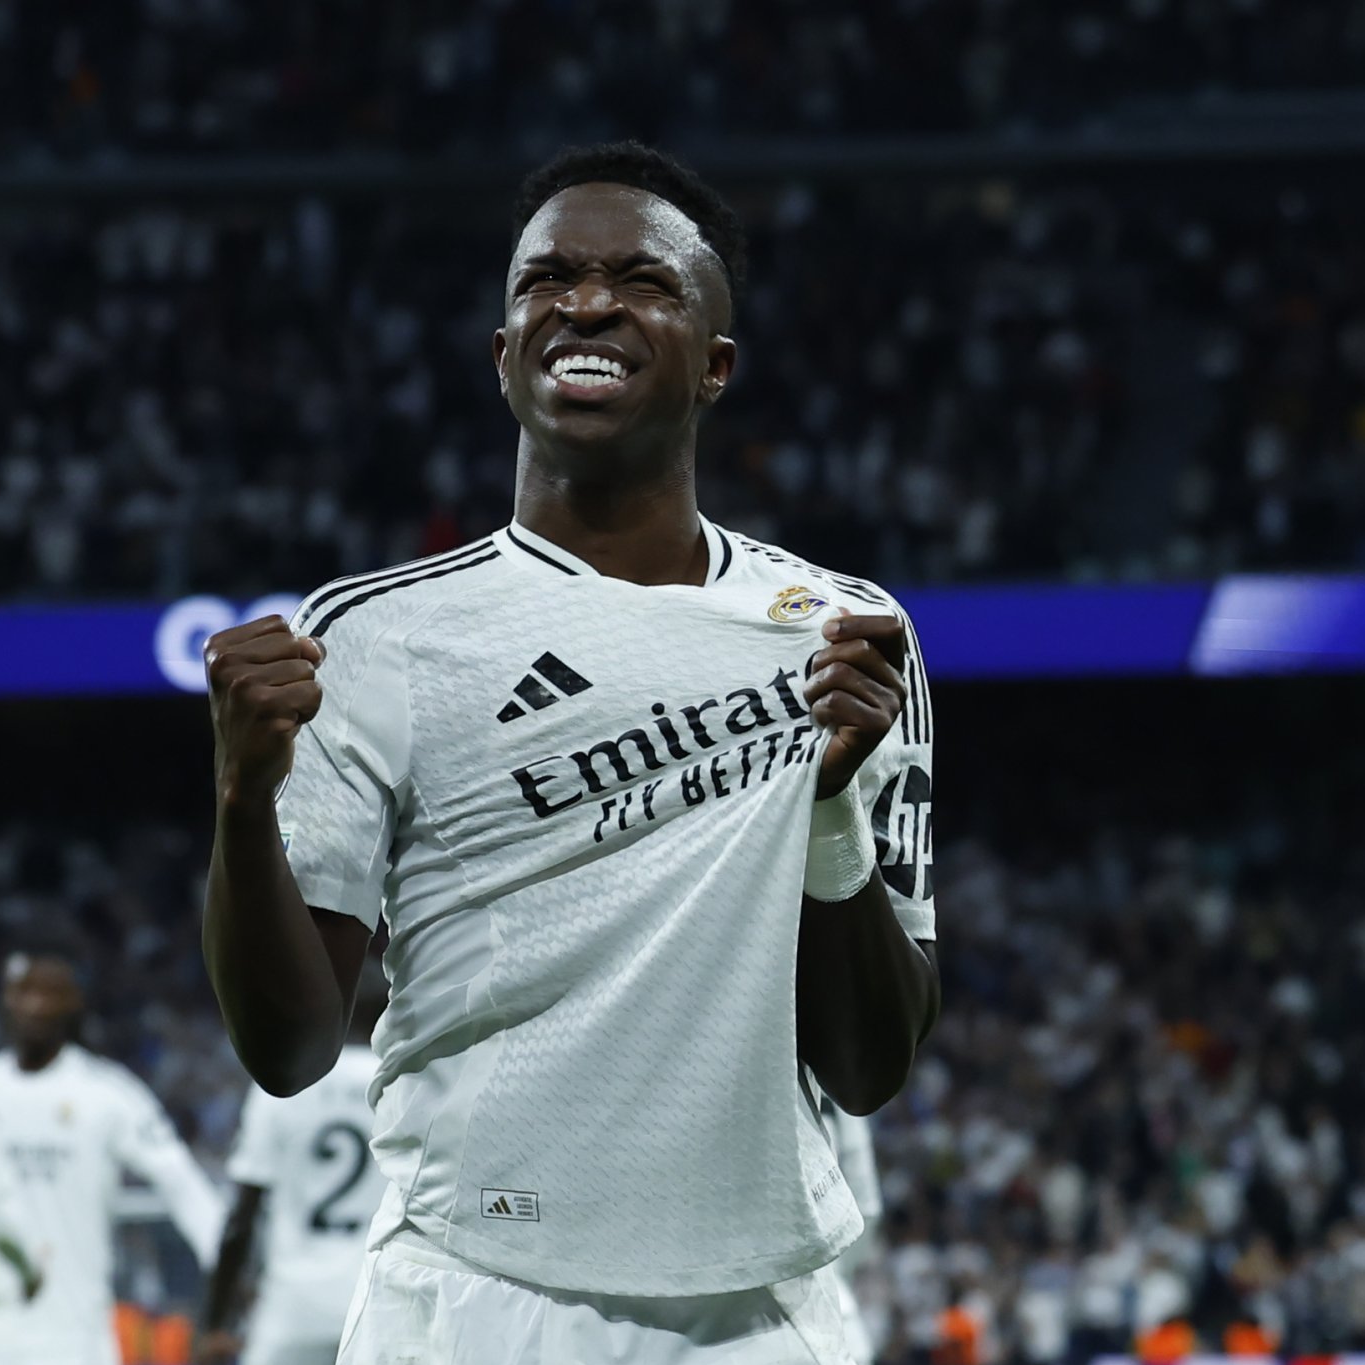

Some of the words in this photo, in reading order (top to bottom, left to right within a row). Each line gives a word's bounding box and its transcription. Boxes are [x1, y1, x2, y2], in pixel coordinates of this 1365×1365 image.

[511, 650, 823, 819] Emirat
[881, 763, 934, 901] hp
[309, 1119, 369, 1233] 2
